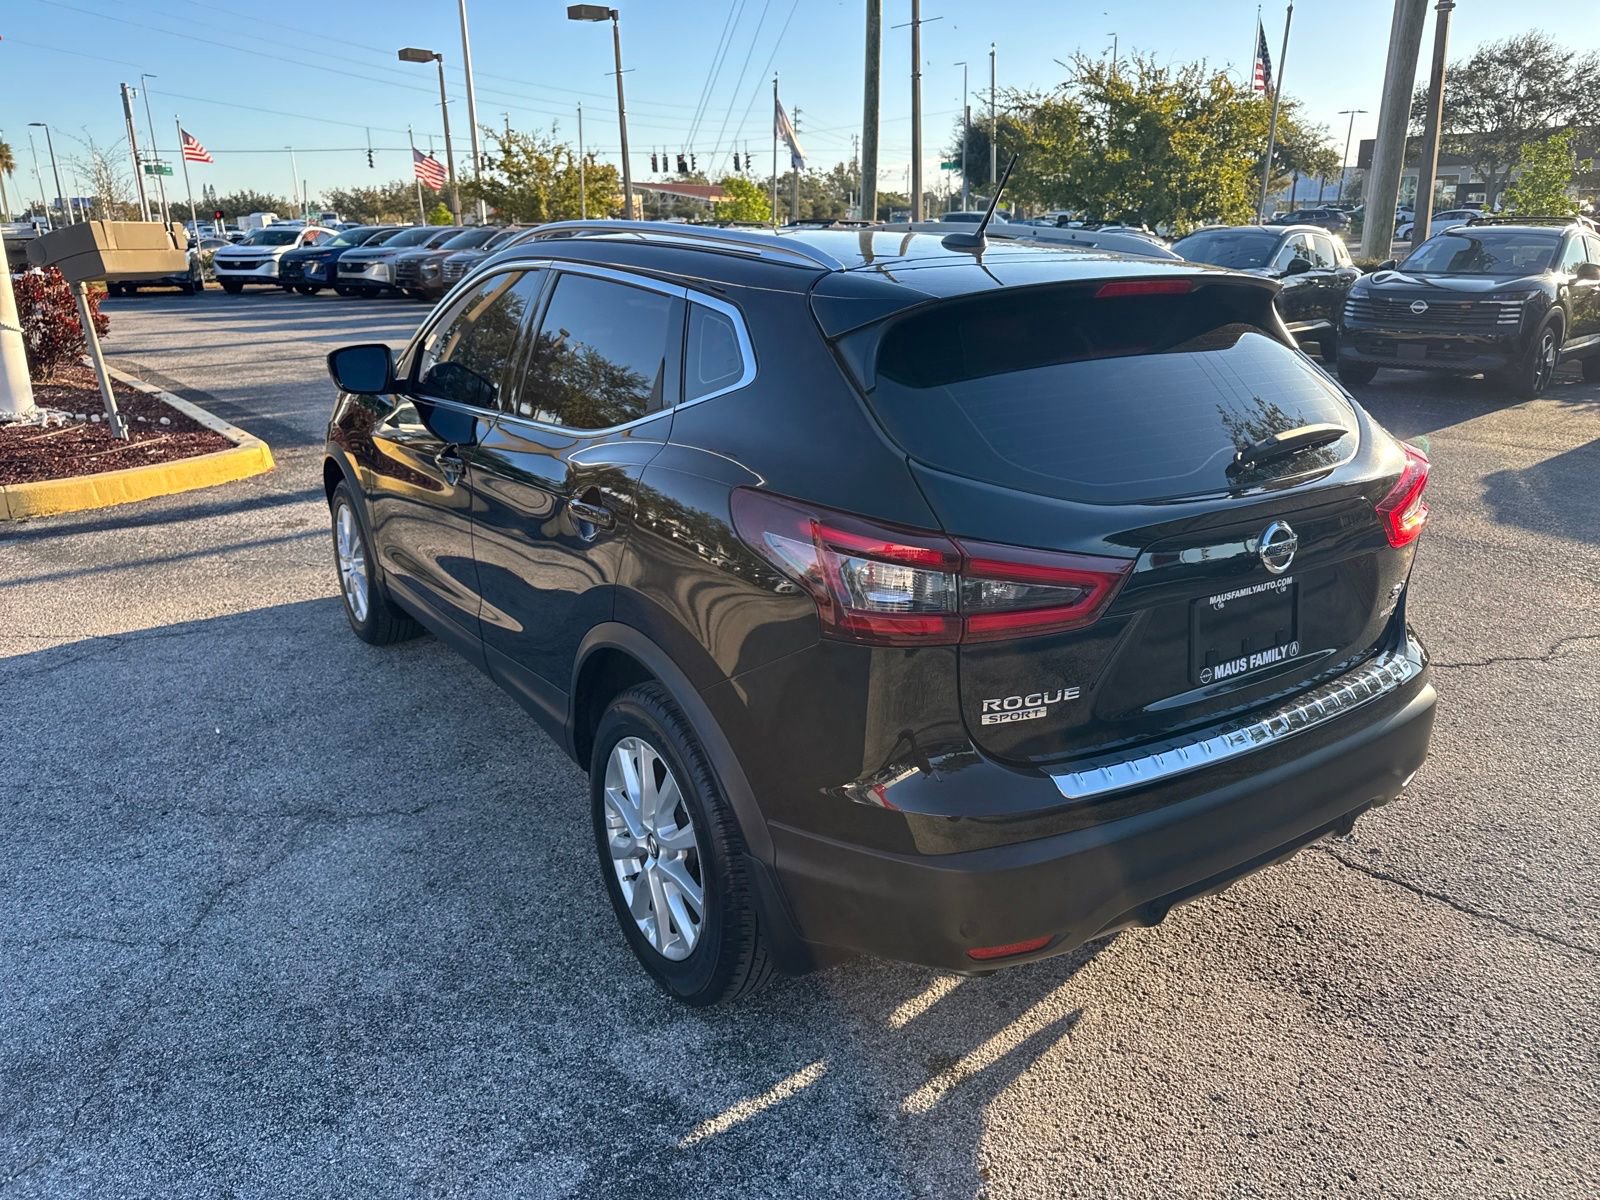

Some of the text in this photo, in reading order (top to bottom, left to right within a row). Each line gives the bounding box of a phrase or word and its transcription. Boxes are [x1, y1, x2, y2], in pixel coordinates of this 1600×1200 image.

[1209, 576, 1293, 605] MAUSFAMILYAUTO.COM
[1214, 644, 1288, 680] MAUS FAMILY
[982, 686, 1081, 713] ROGUE
[988, 708, 1042, 723] SPORT
